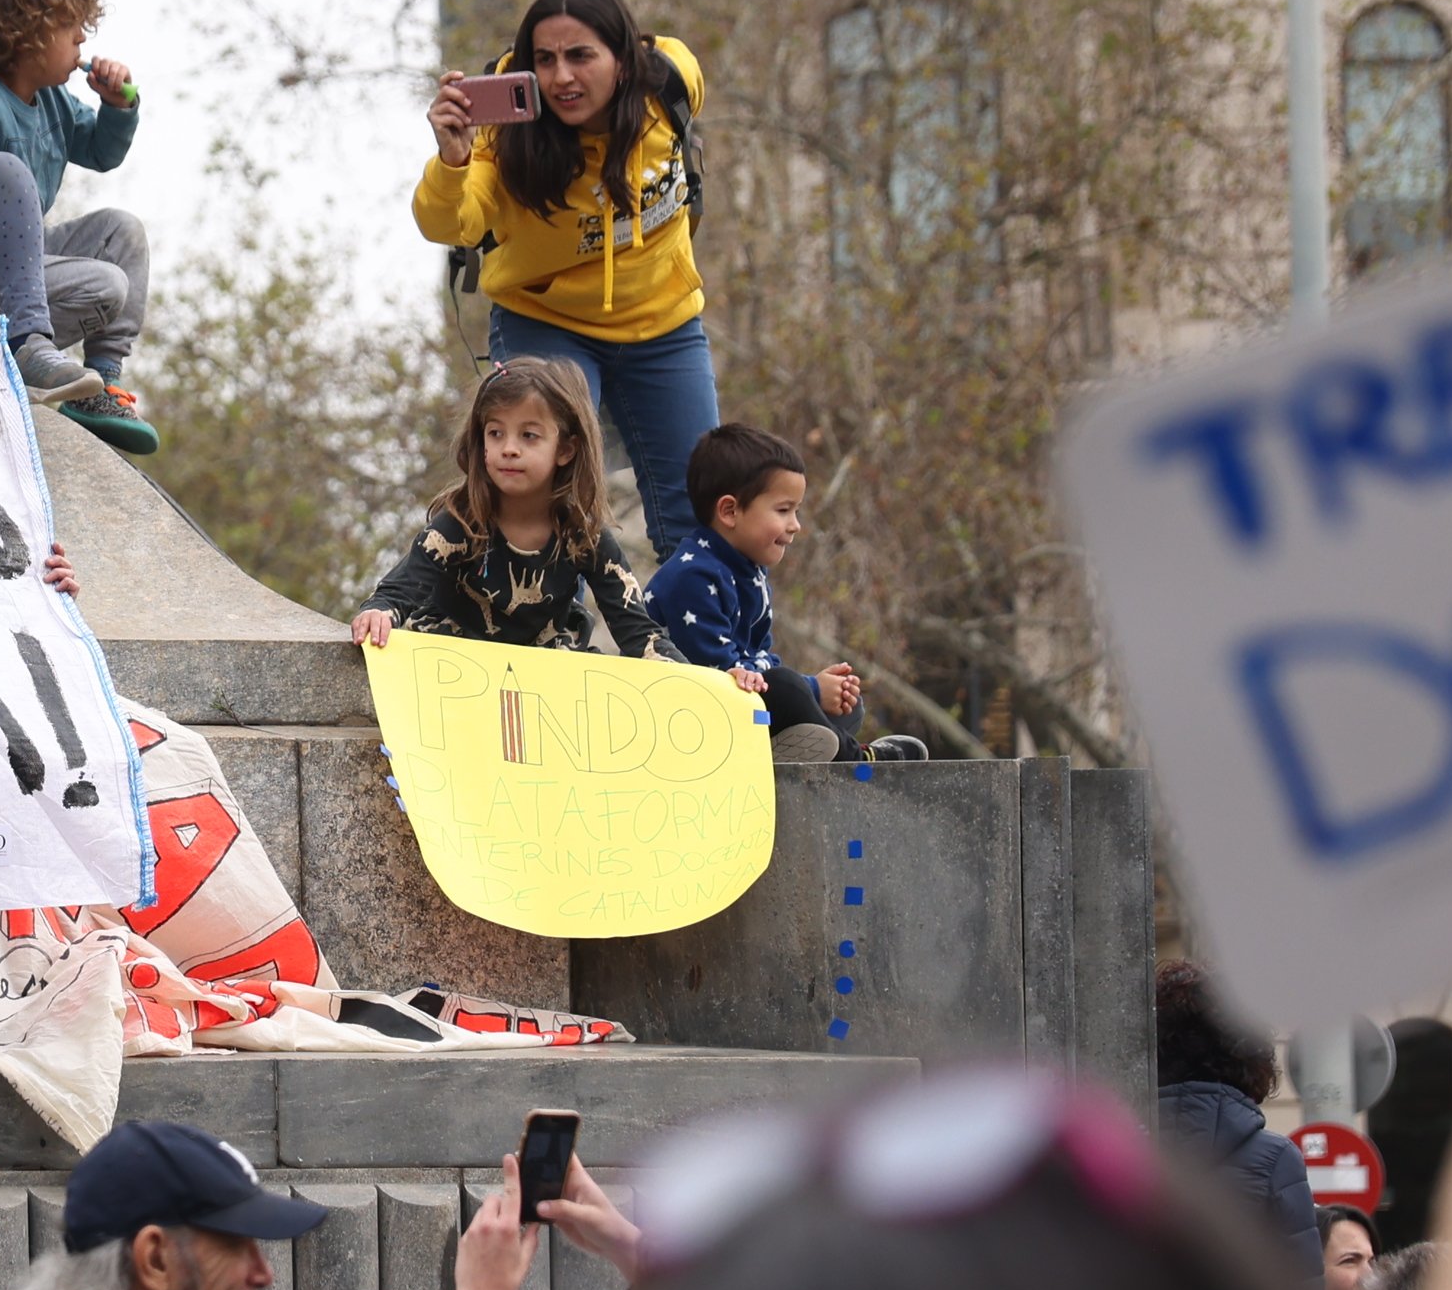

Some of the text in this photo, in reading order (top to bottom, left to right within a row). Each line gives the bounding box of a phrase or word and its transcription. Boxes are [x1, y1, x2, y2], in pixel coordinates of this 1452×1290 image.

[412, 646, 734, 782] PINDO
[406, 753, 771, 844] PLATAFORMA
[472, 861, 759, 921] DE CATALUNYA
